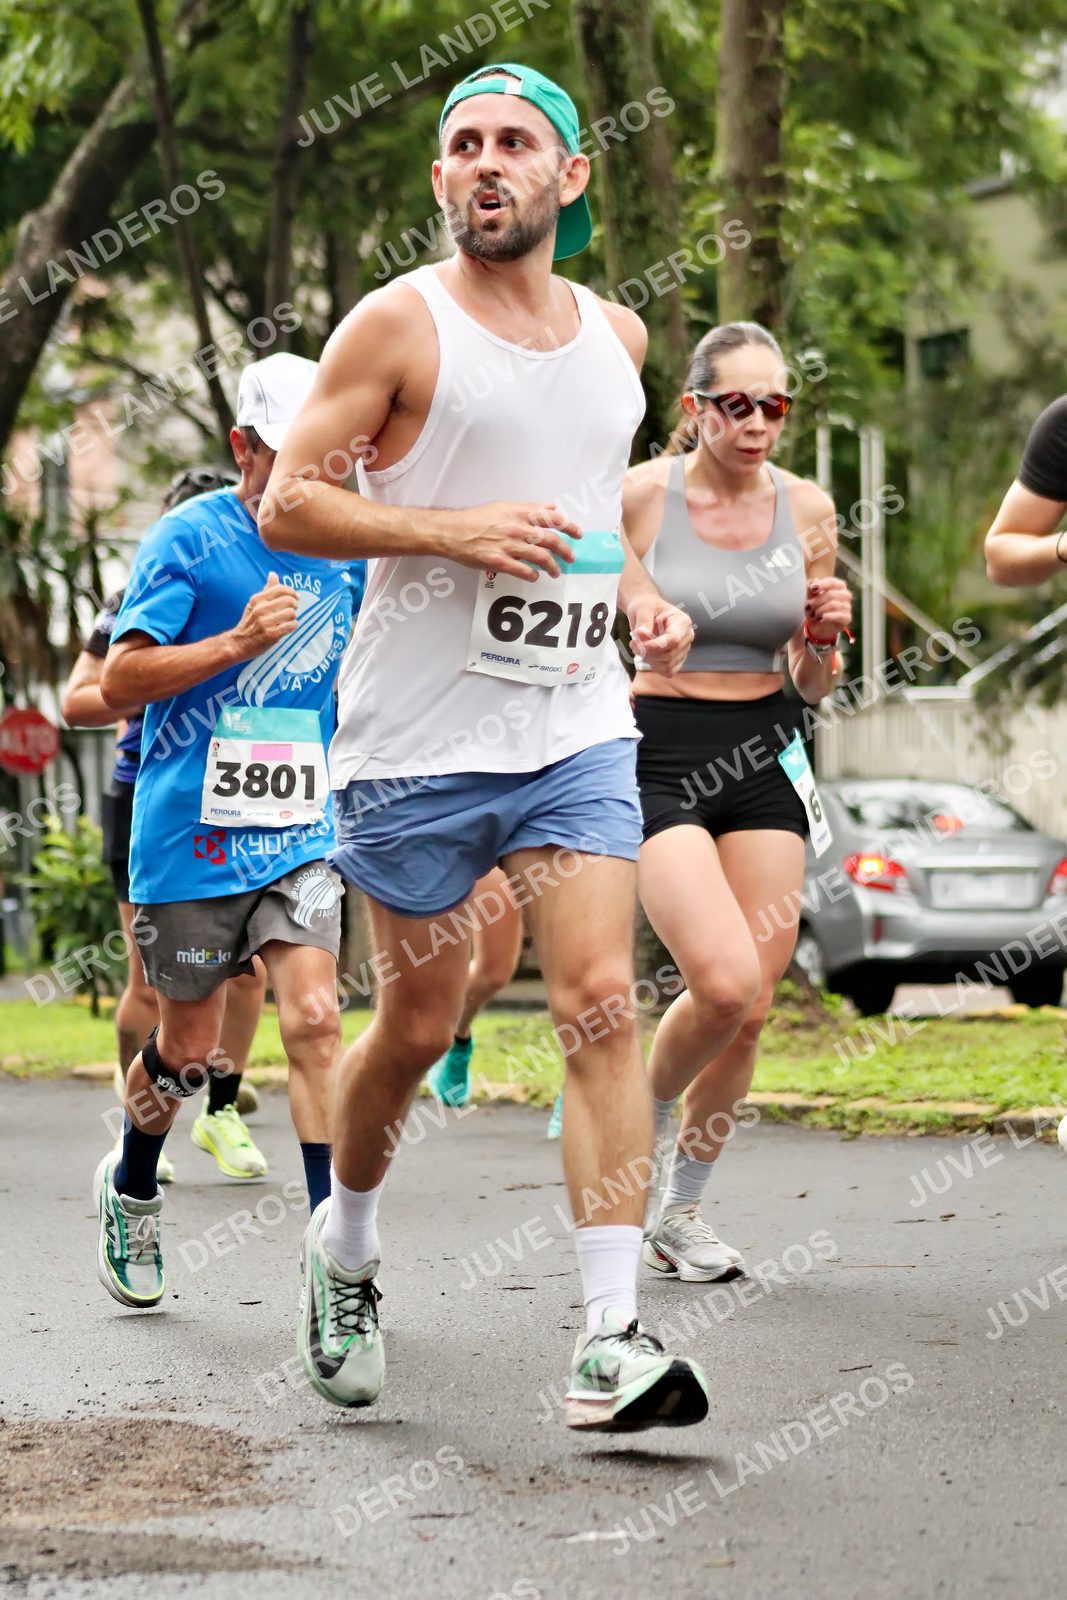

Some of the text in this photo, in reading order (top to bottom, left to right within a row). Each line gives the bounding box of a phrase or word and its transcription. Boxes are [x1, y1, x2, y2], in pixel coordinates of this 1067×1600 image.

[487, 595, 609, 649] 6218
[481, 652, 521, 665] PERDURA
[212, 761, 315, 801] 3801
[210, 808, 242, 817] PERDURA
